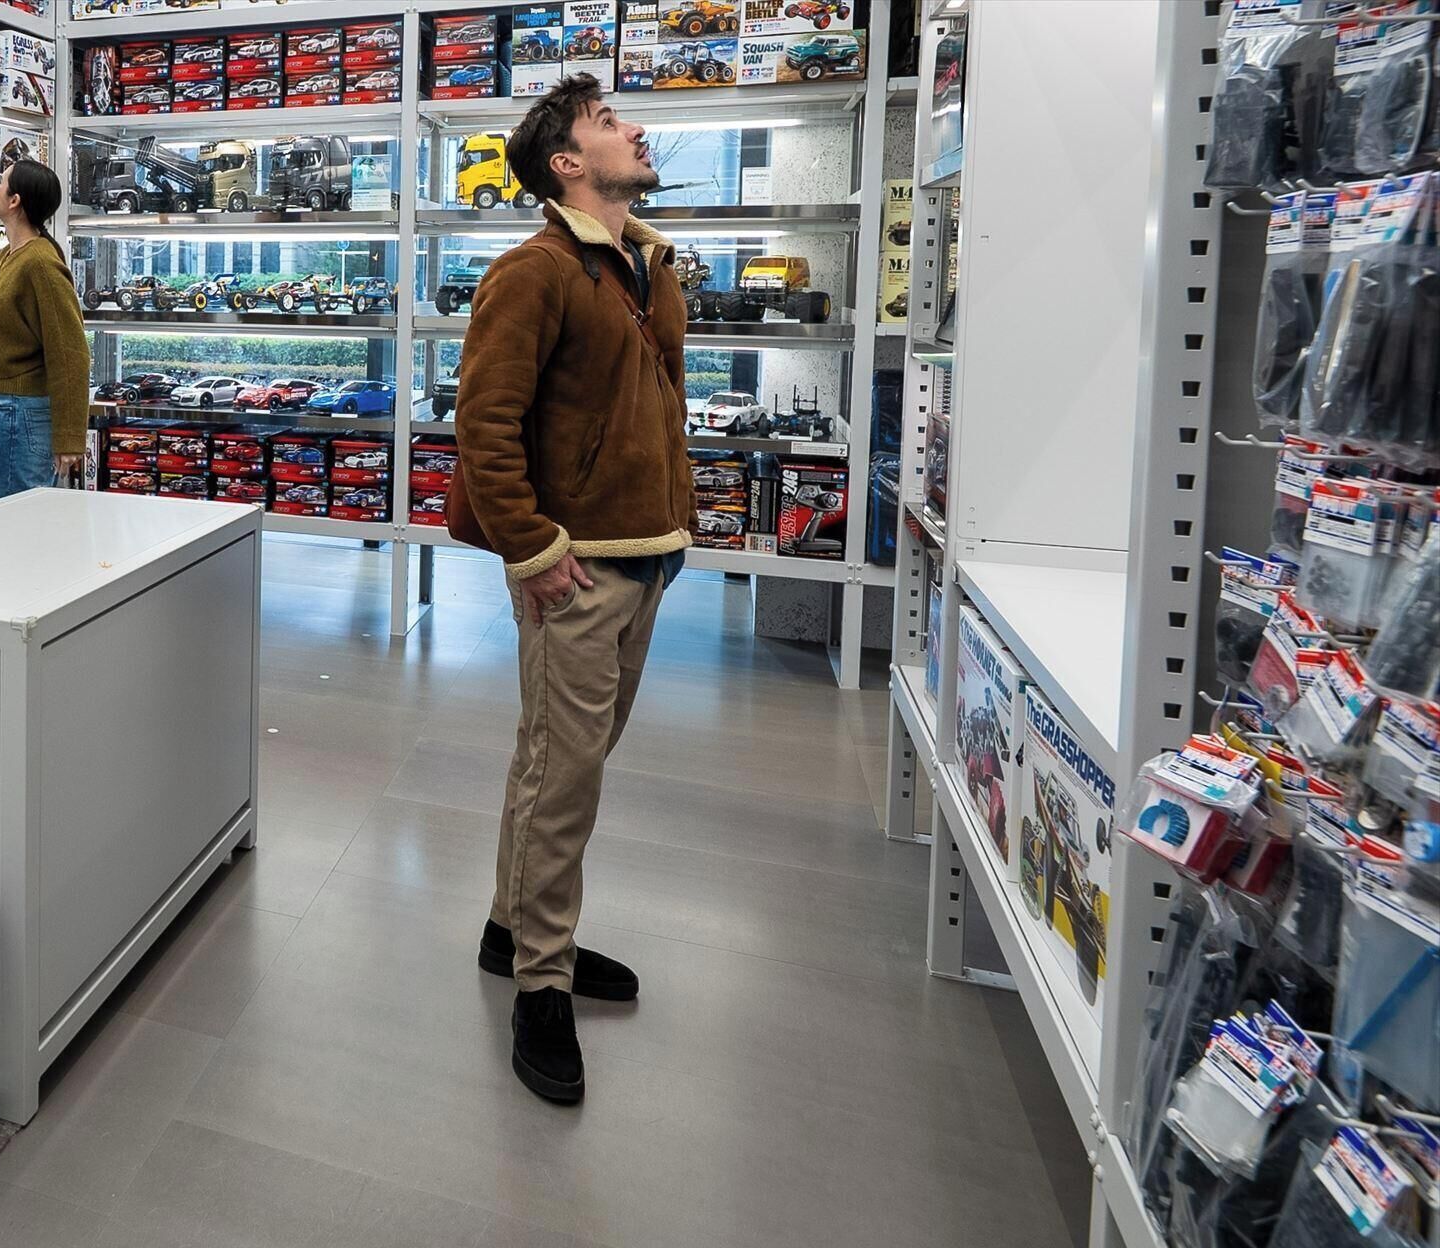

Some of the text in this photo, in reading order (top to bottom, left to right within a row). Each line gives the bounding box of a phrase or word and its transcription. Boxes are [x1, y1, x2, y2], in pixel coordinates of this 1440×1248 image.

[570, 3, 610, 12] MONSTER
[745, 0, 784, 11] BLITZER
[575, 10, 607, 18] BEETLE
[744, 7, 779, 20] BEETLE
[13, 35, 33, 50] EGRESS
[742, 42, 784, 54] SQUASH
[743, 54, 763, 65] VAN
[780, 495, 797, 555] FINESPEC
[972, 630, 996, 681] HORNET
[1026, 694, 1042, 731] The
